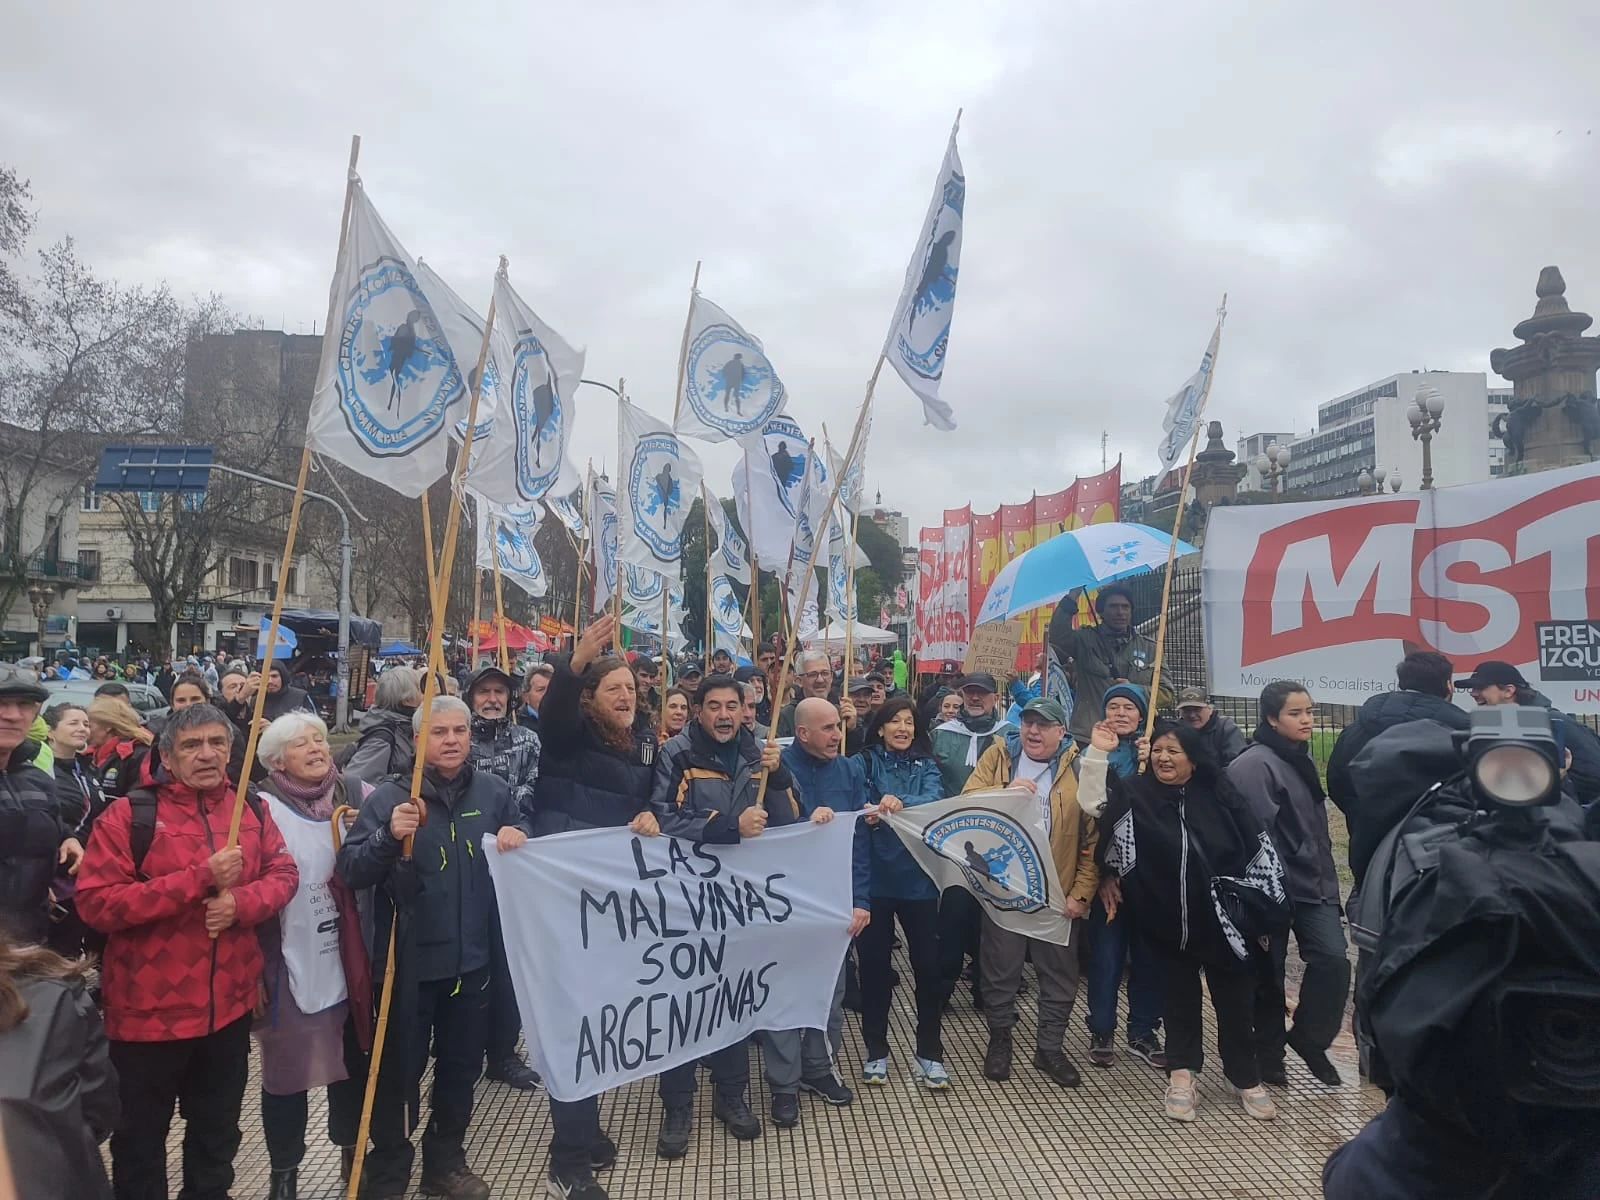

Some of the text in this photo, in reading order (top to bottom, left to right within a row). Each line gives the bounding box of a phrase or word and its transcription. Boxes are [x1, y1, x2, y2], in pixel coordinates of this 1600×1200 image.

[1271, 499, 1600, 655] MST
[1319, 676, 1383, 691] Socialista
[631, 836, 722, 880] LAS
[993, 822, 1020, 845] ISLAS
[1018, 846, 1039, 900] MALVINAS
[580, 874, 793, 950] MALVINAS
[636, 934, 725, 986] SON
[575, 961, 778, 1084] ARGENTINAS
